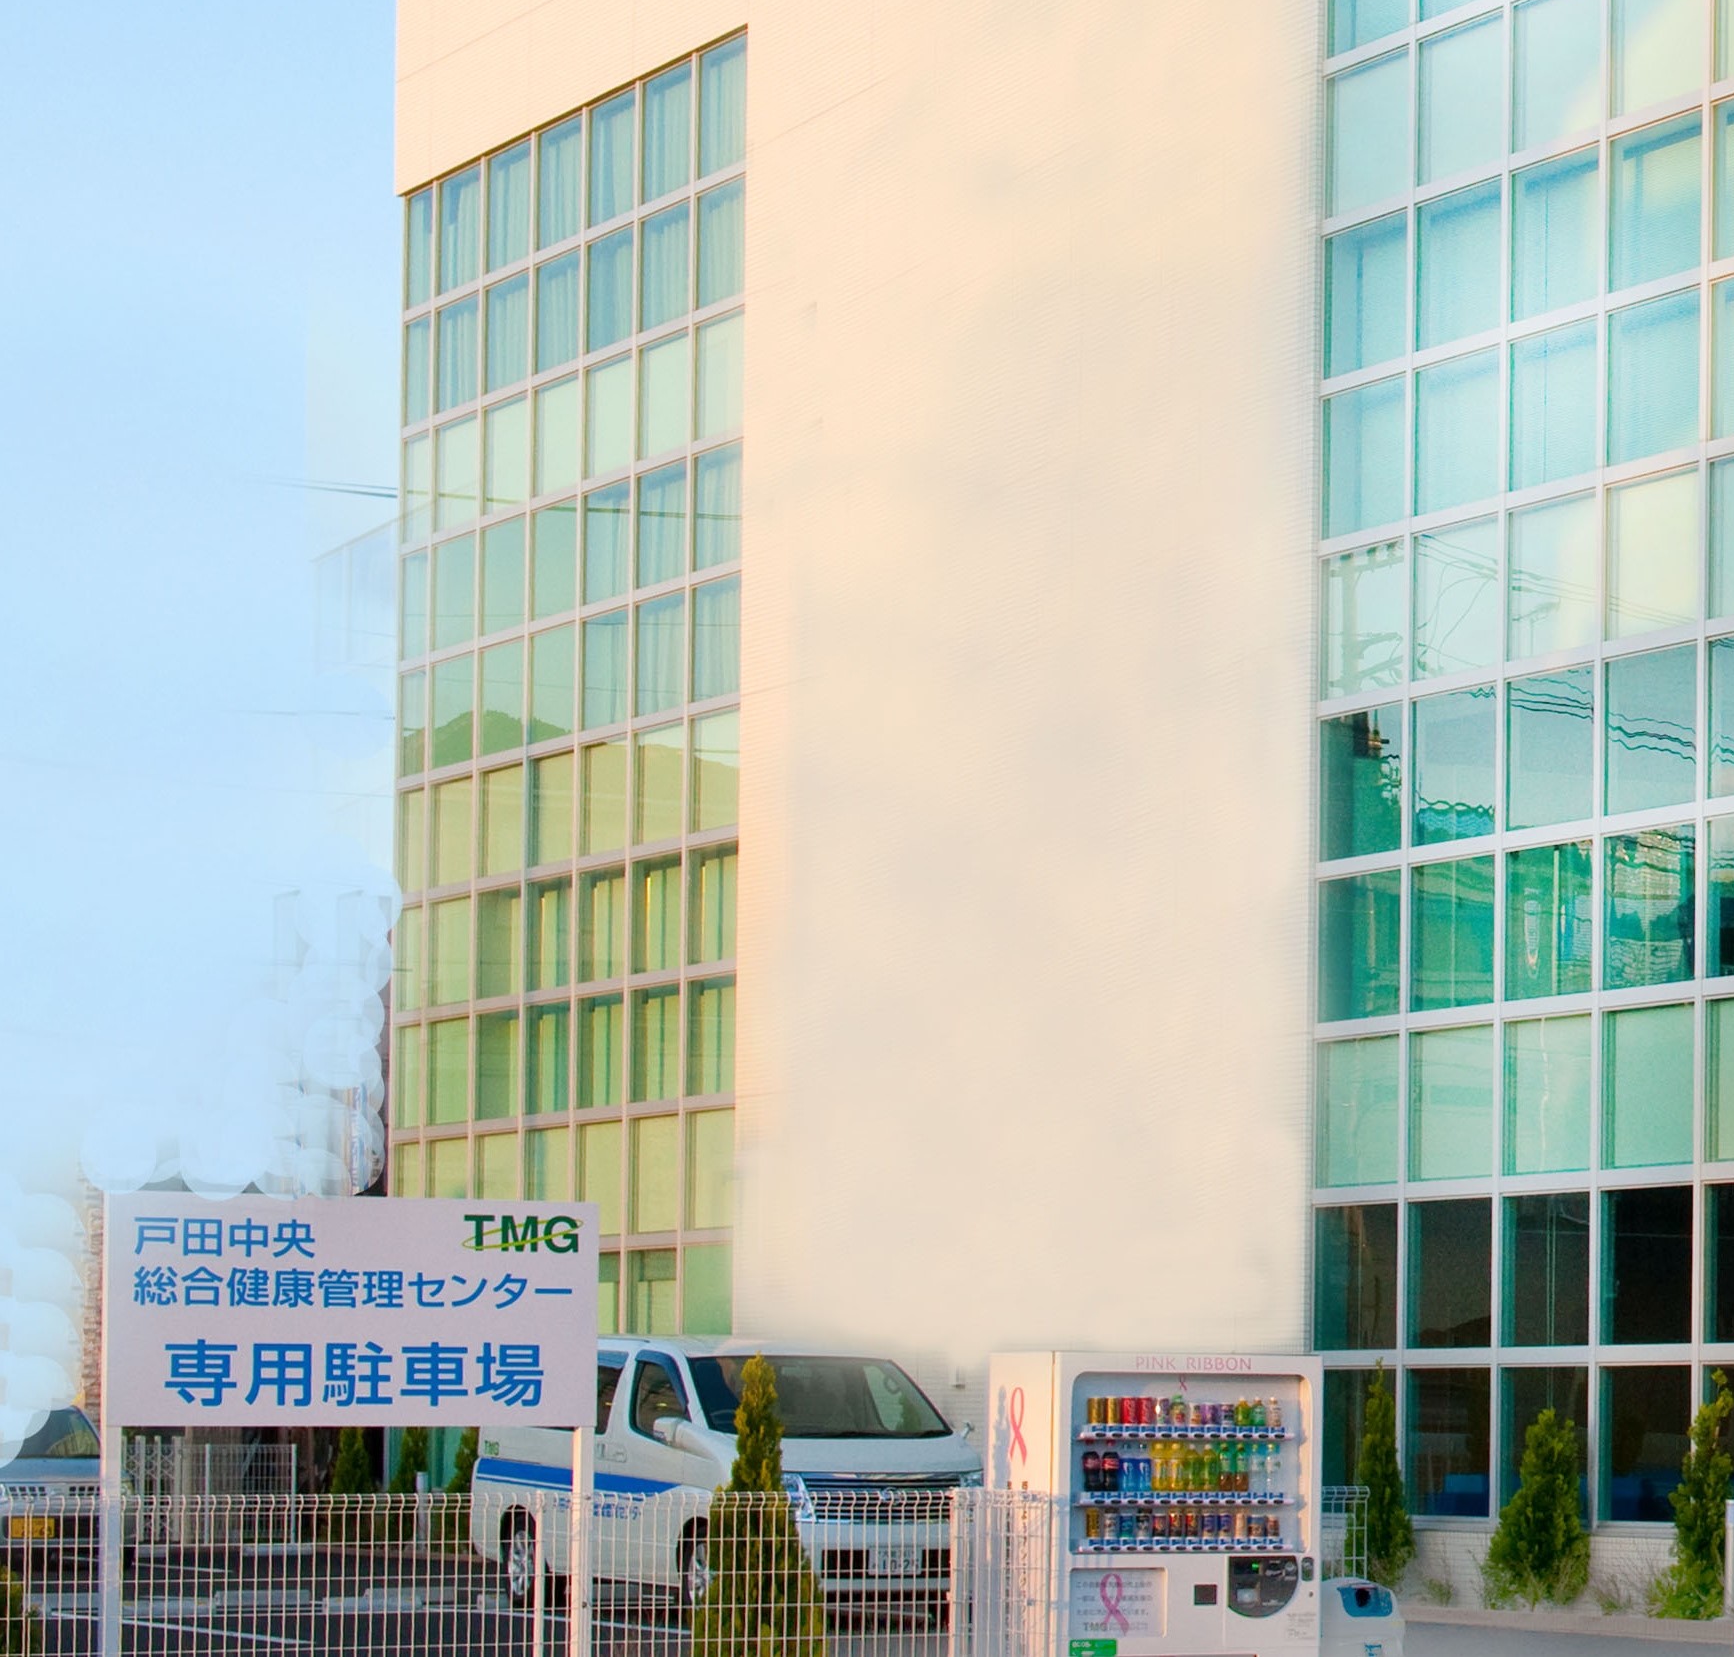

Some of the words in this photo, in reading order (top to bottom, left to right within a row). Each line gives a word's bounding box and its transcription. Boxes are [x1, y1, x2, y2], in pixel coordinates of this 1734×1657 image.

[133, 1217, 316, 1259] 戸田中央
[463, 1214, 583, 1254] TMG
[133, 1266, 573, 1310] 総合健康管理センター
[163, 1338, 545, 1408] 専用駐車場
[1135, 1356, 1177, 1371] PINK
[1186, 1356, 1252, 1372] RIBBON
